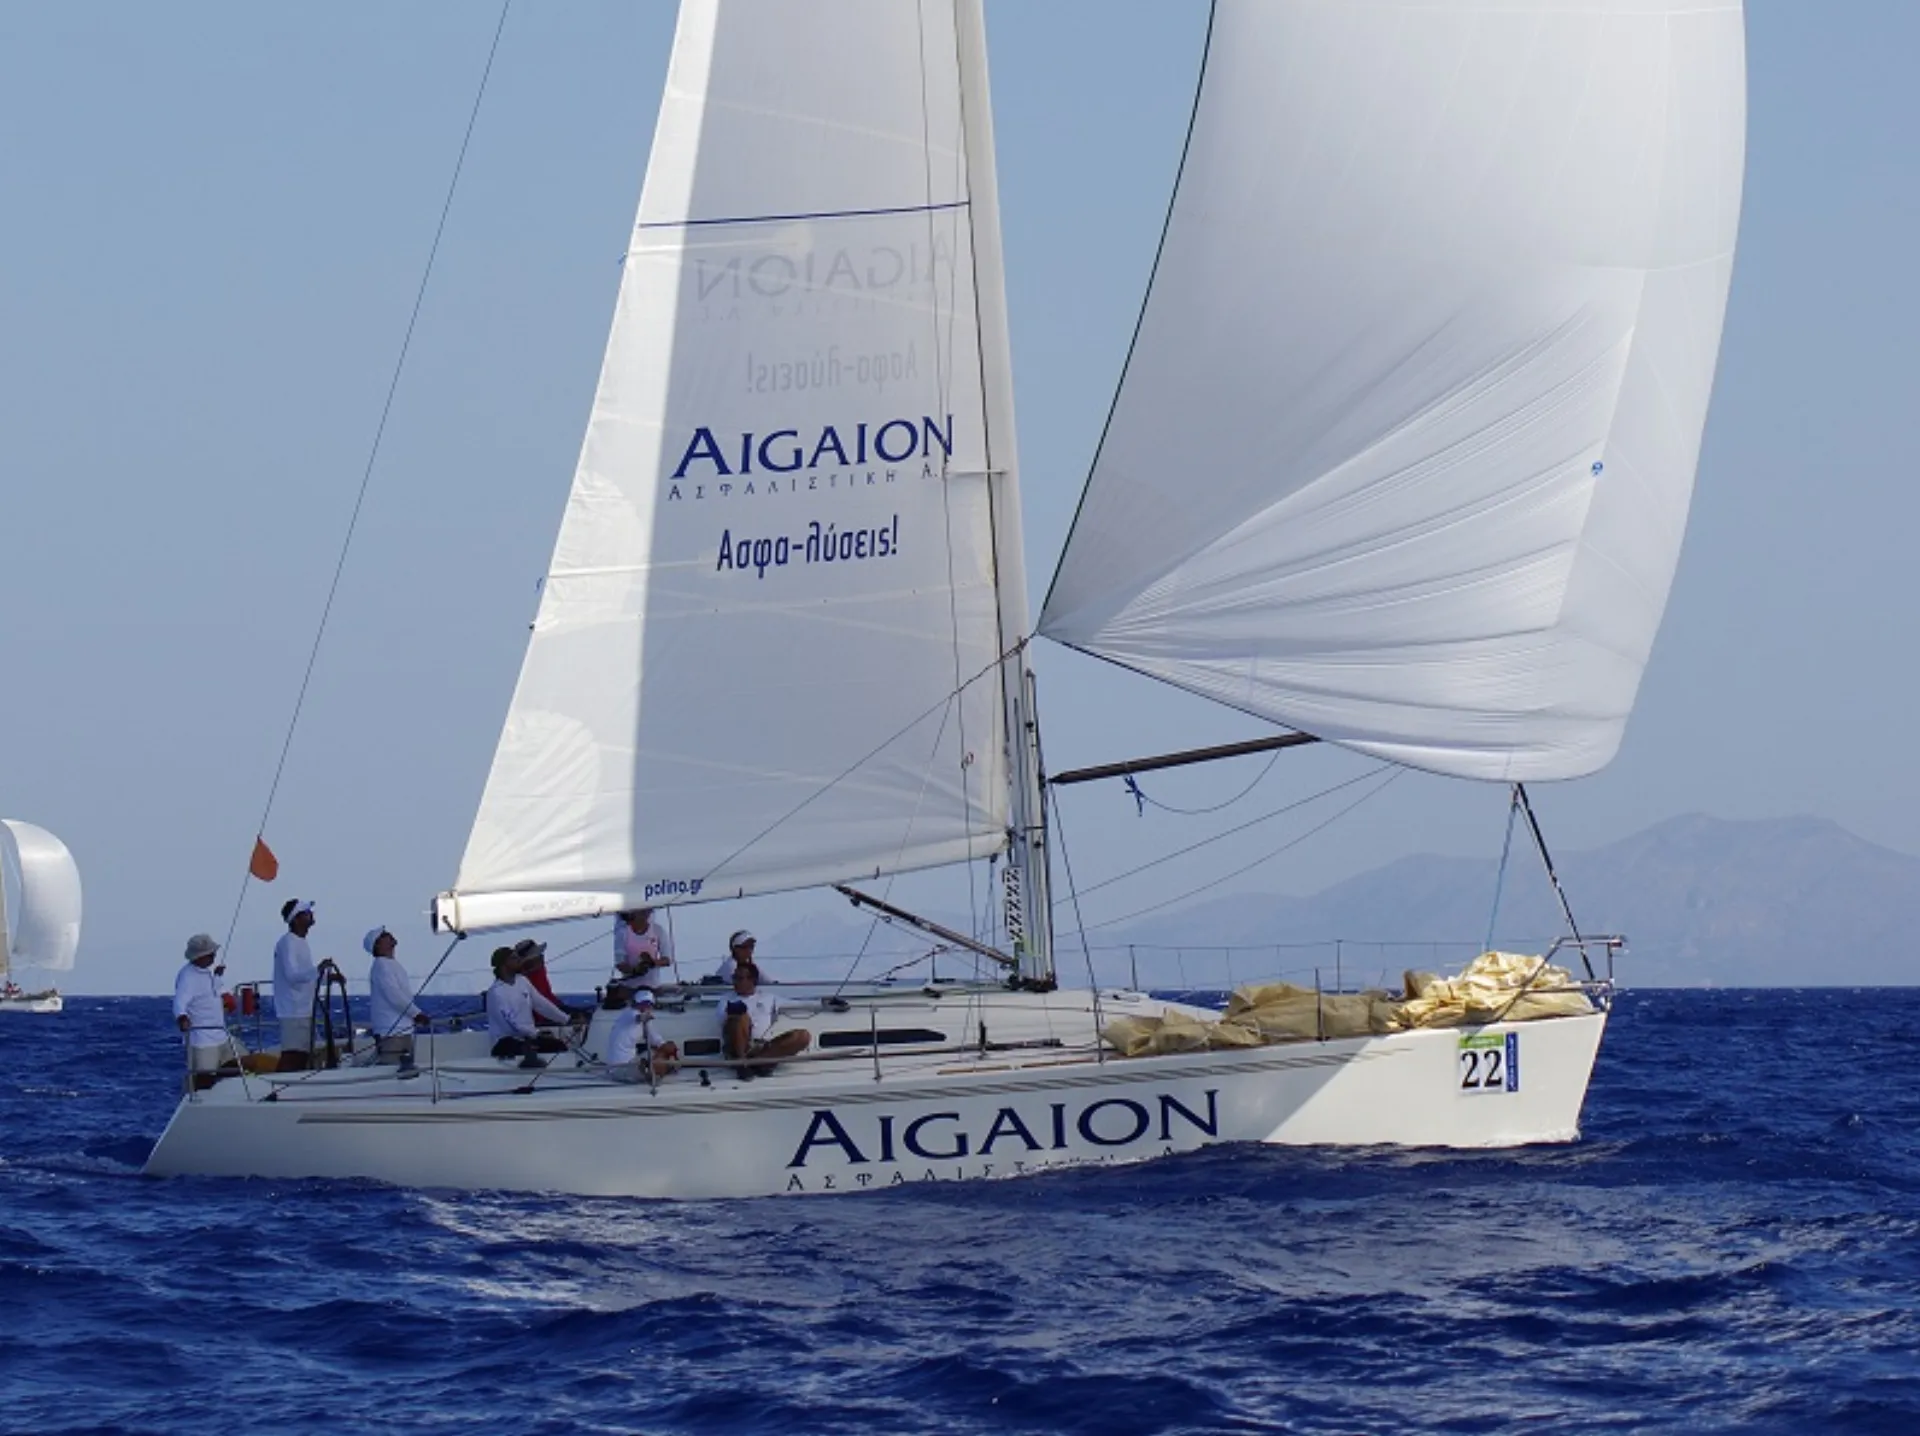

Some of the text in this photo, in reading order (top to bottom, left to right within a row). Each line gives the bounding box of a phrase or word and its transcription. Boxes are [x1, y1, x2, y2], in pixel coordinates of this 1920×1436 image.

[670, 414, 953, 479] AIGAION
[717, 514, 898, 579] Ασφα-λύσεις!
[645, 879, 704, 901] polino.gr
[1461, 1049, 1502, 1088] 22
[785, 1089, 1219, 1169] AIGAION
